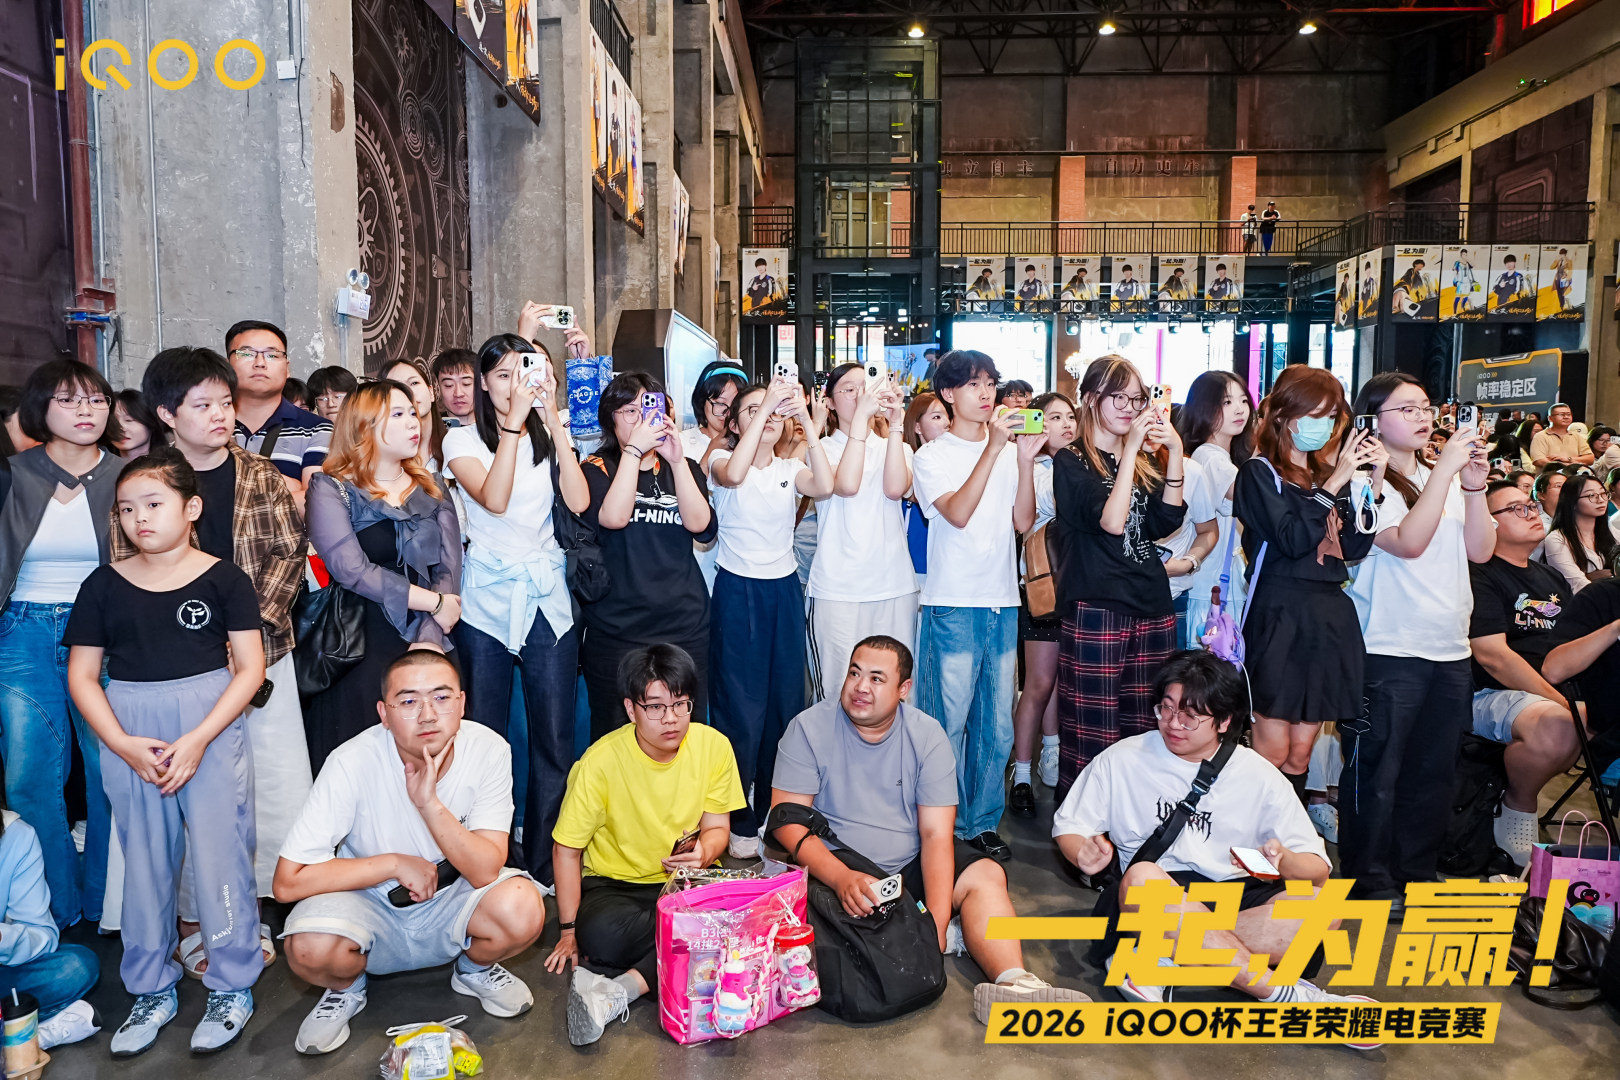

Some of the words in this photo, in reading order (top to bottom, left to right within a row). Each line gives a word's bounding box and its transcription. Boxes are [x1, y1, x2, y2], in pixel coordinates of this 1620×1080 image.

[1105, 158, 1200, 177] 自力更生
[1476, 377, 1537, 401] 帧率稳定区
[629, 508, 683, 526] I-NING
[1515, 613, 1557, 629] LI-NIN
